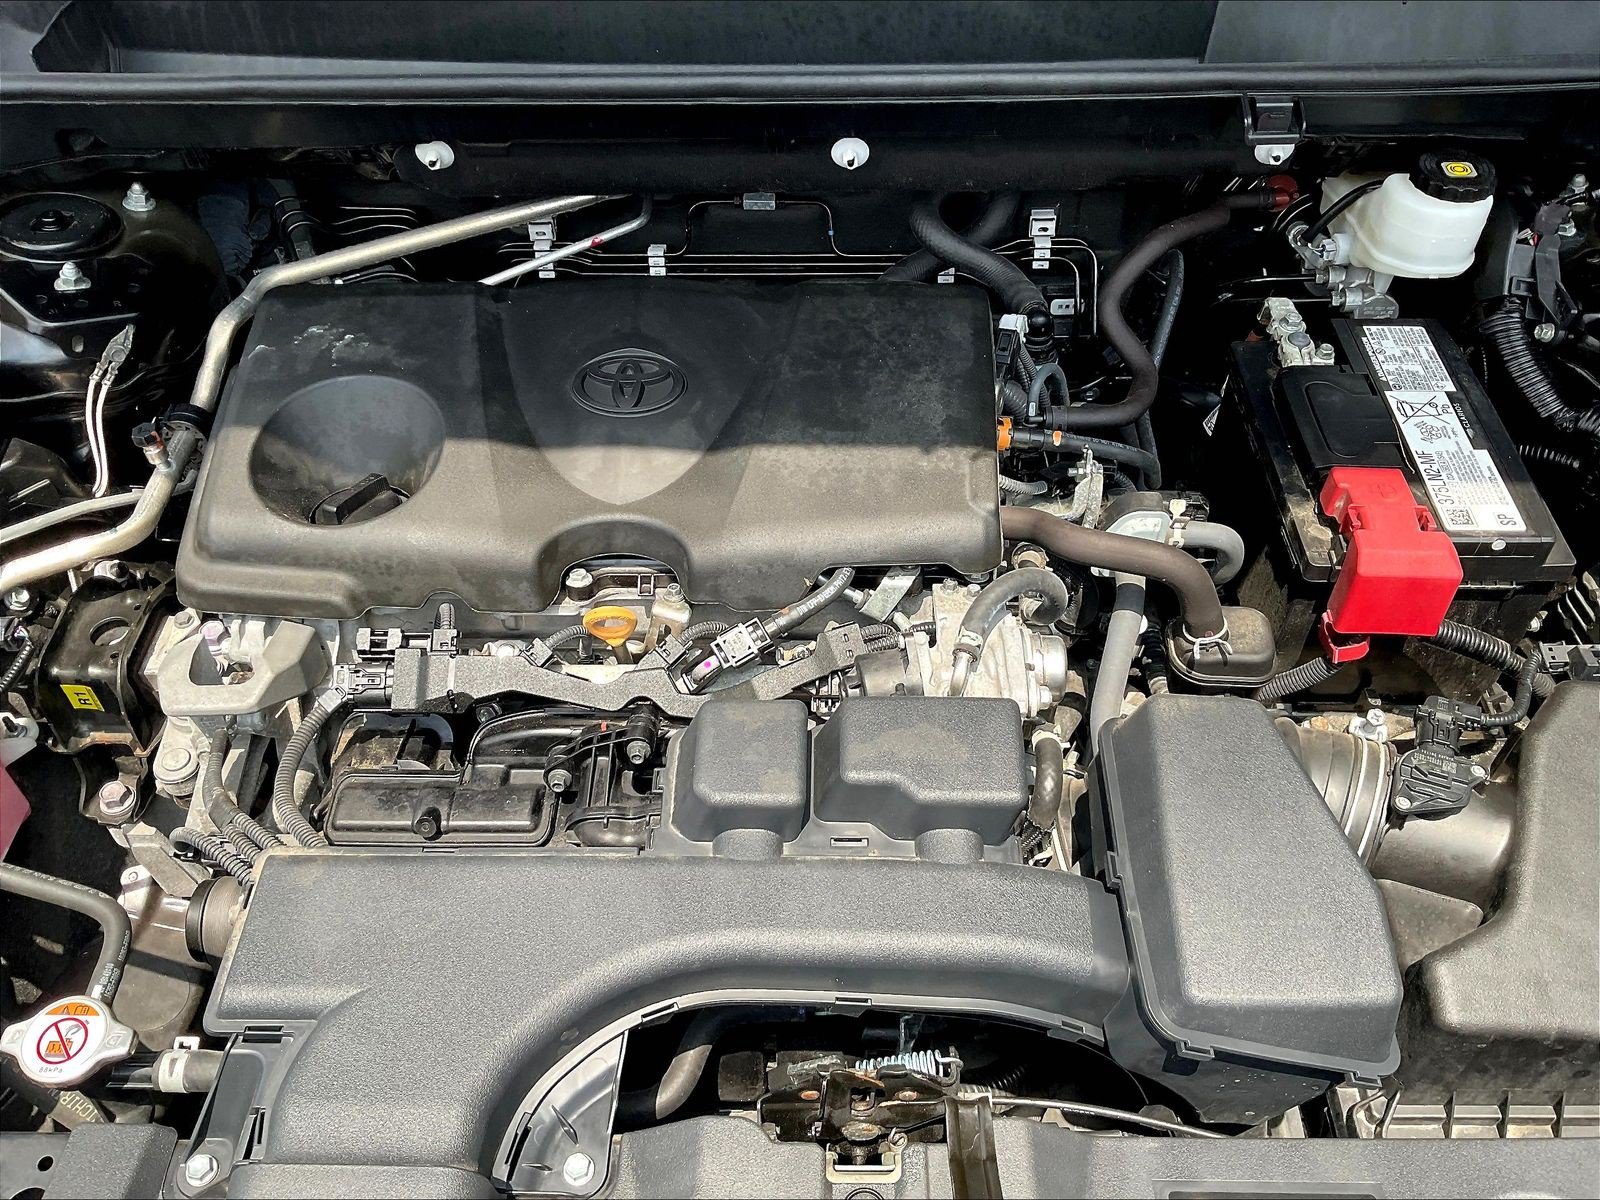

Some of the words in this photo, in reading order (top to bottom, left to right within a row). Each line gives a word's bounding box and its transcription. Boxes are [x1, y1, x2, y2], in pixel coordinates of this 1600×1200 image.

[1453, 402, 1471, 430] CLARIOS
[1415, 450, 1455, 505] 375LN2-MF
[1497, 513, 1517, 526] SP
[74, 692, 92, 705] R1
